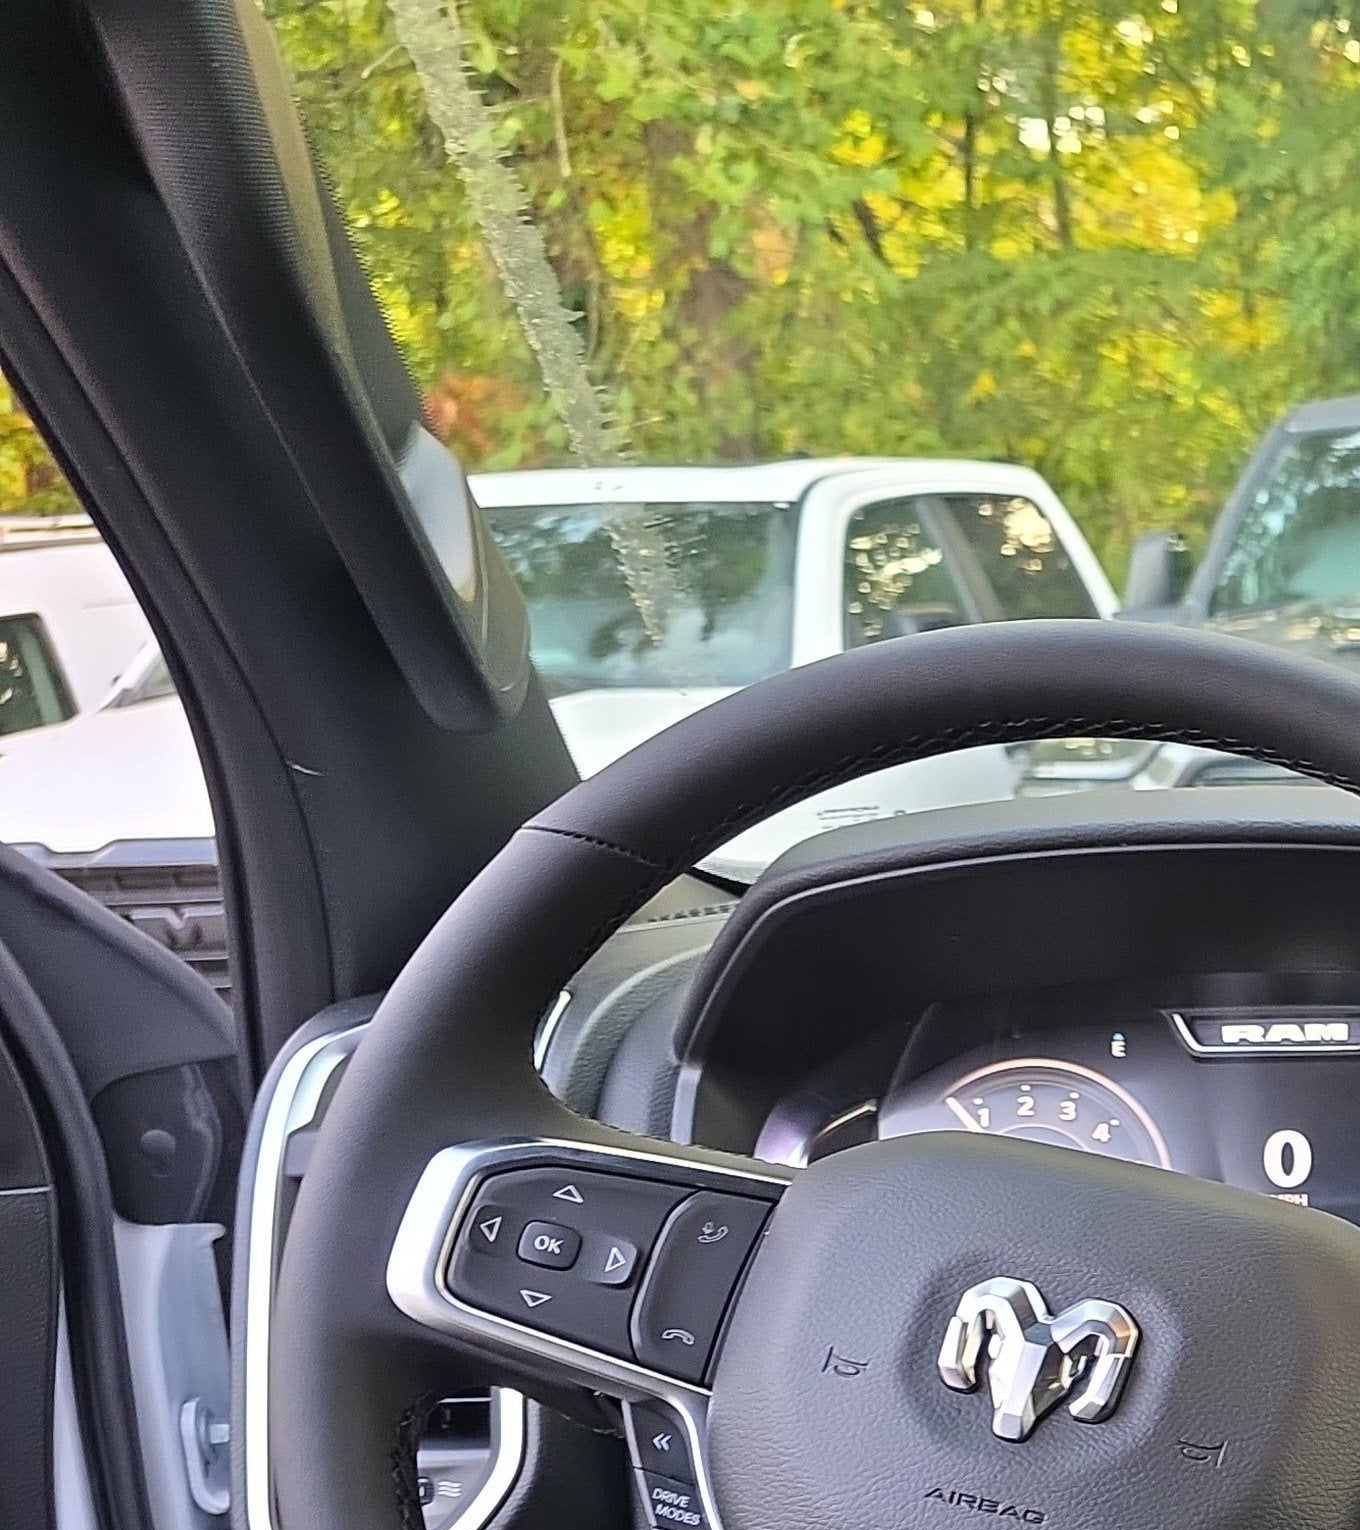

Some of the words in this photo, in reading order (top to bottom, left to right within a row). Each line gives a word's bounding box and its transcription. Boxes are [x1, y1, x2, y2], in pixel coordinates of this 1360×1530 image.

[1222, 1023, 1350, 1044] RAM
[1111, 1040, 1127, 1058] E
[1017, 1096, 1035, 1117] 2
[1059, 1101, 1078, 1121] 3
[977, 1108, 990, 1128] 1
[1092, 1123, 1111, 1142] 4
[1263, 1129, 1312, 1189] 0
[534, 1235, 562, 1256] OK
[651, 1487, 691, 1508] DRIVE
[924, 1487, 1046, 1524] AIRBAG
[655, 1503, 701, 1526] MODES
